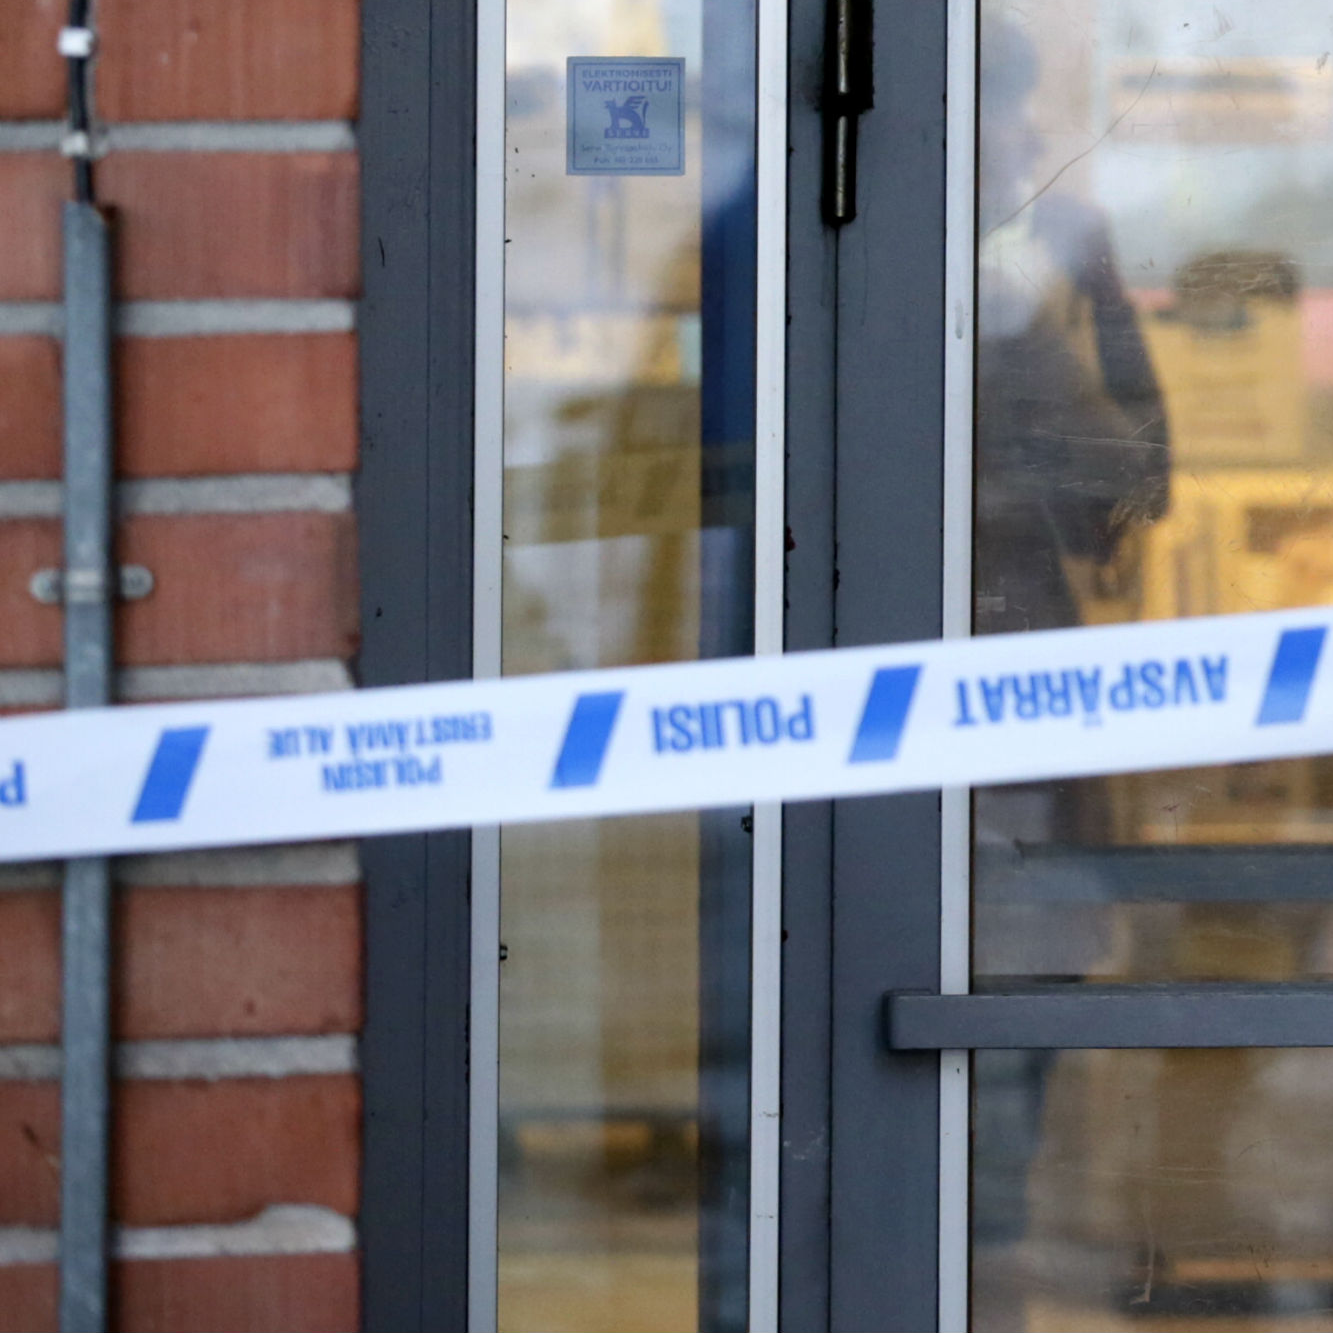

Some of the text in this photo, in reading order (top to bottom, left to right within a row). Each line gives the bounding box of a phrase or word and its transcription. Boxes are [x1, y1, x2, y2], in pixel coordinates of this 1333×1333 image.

[583, 80, 672, 93] VARTIOITU!
[951, 655, 1229, 728] AVSPÄRRAT
[267, 728, 331, 759] ALUE
[651, 694, 816, 756] POLIISI
